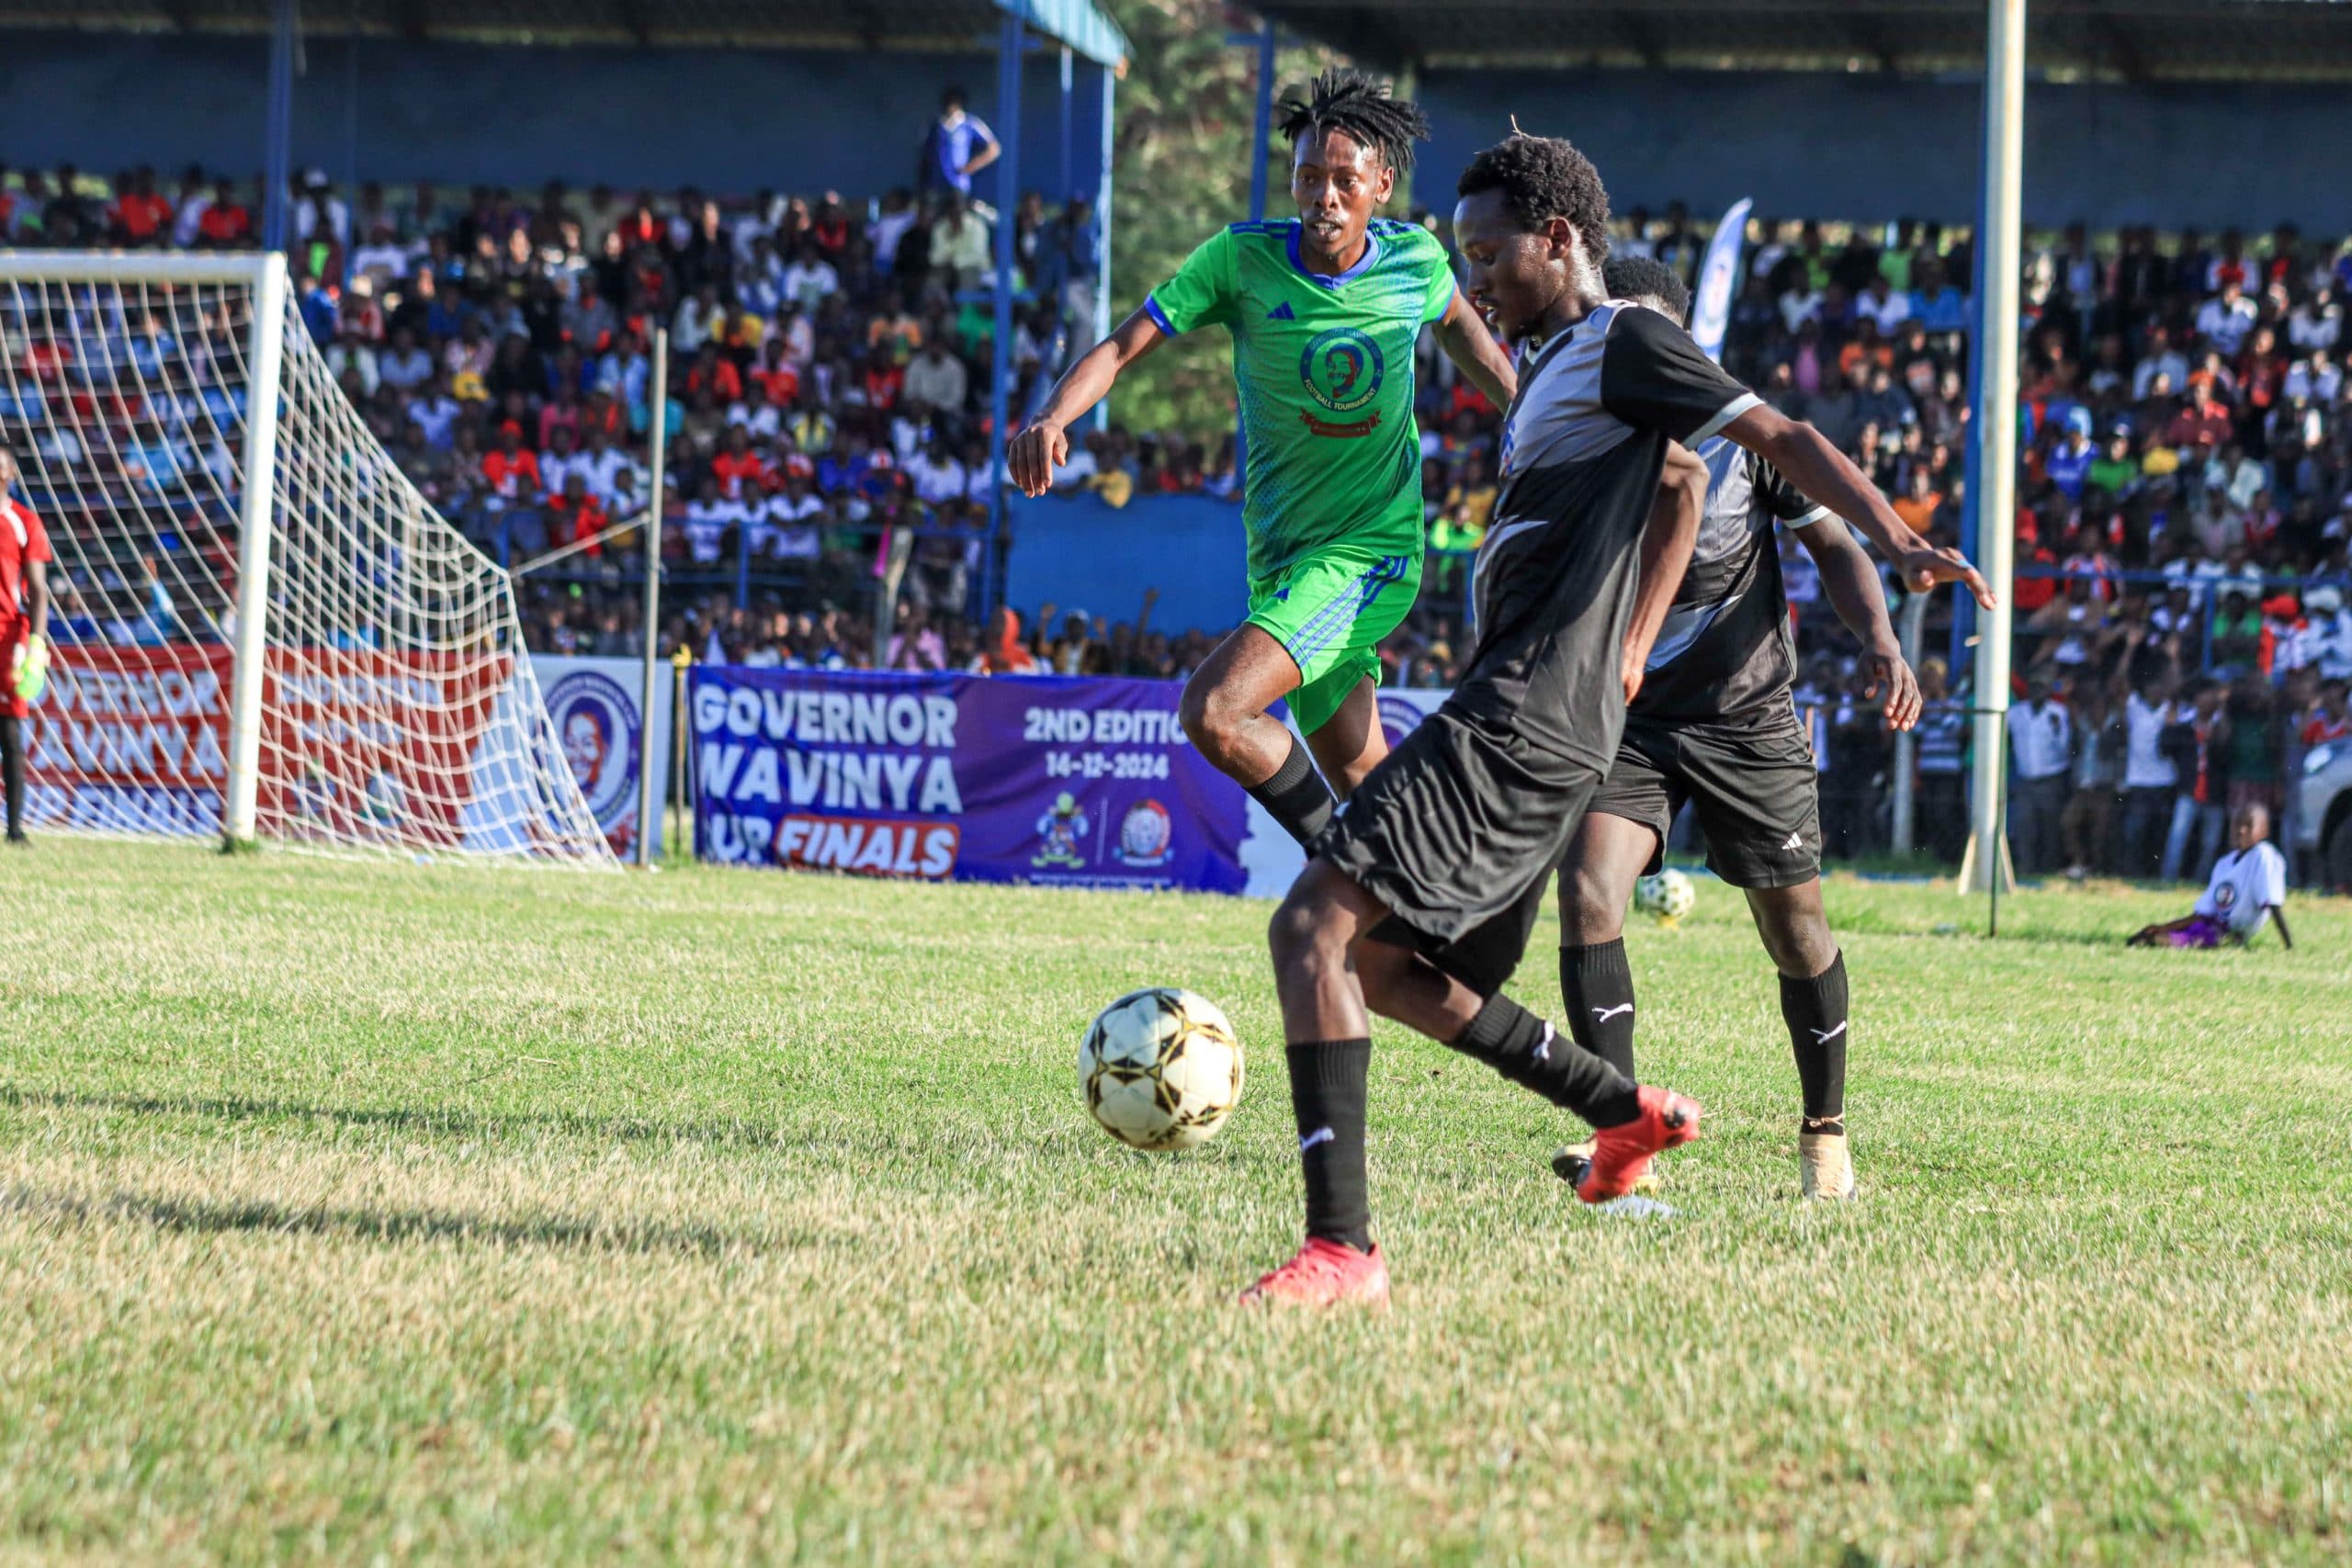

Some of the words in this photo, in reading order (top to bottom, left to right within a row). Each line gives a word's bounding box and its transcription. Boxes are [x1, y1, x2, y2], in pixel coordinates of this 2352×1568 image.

[1305, 378, 1332, 409] FOOTBALL
[1334, 387, 1376, 411] TOURNAMENT
[695, 683, 957, 747] GOVERNOR
[1023, 706, 1091, 742] 2ND
[1093, 709, 1189, 745] EDITIO
[1046, 750, 1169, 780] 14-12-2024
[702, 814, 773, 862] UP
[778, 819, 956, 875] FINALS
